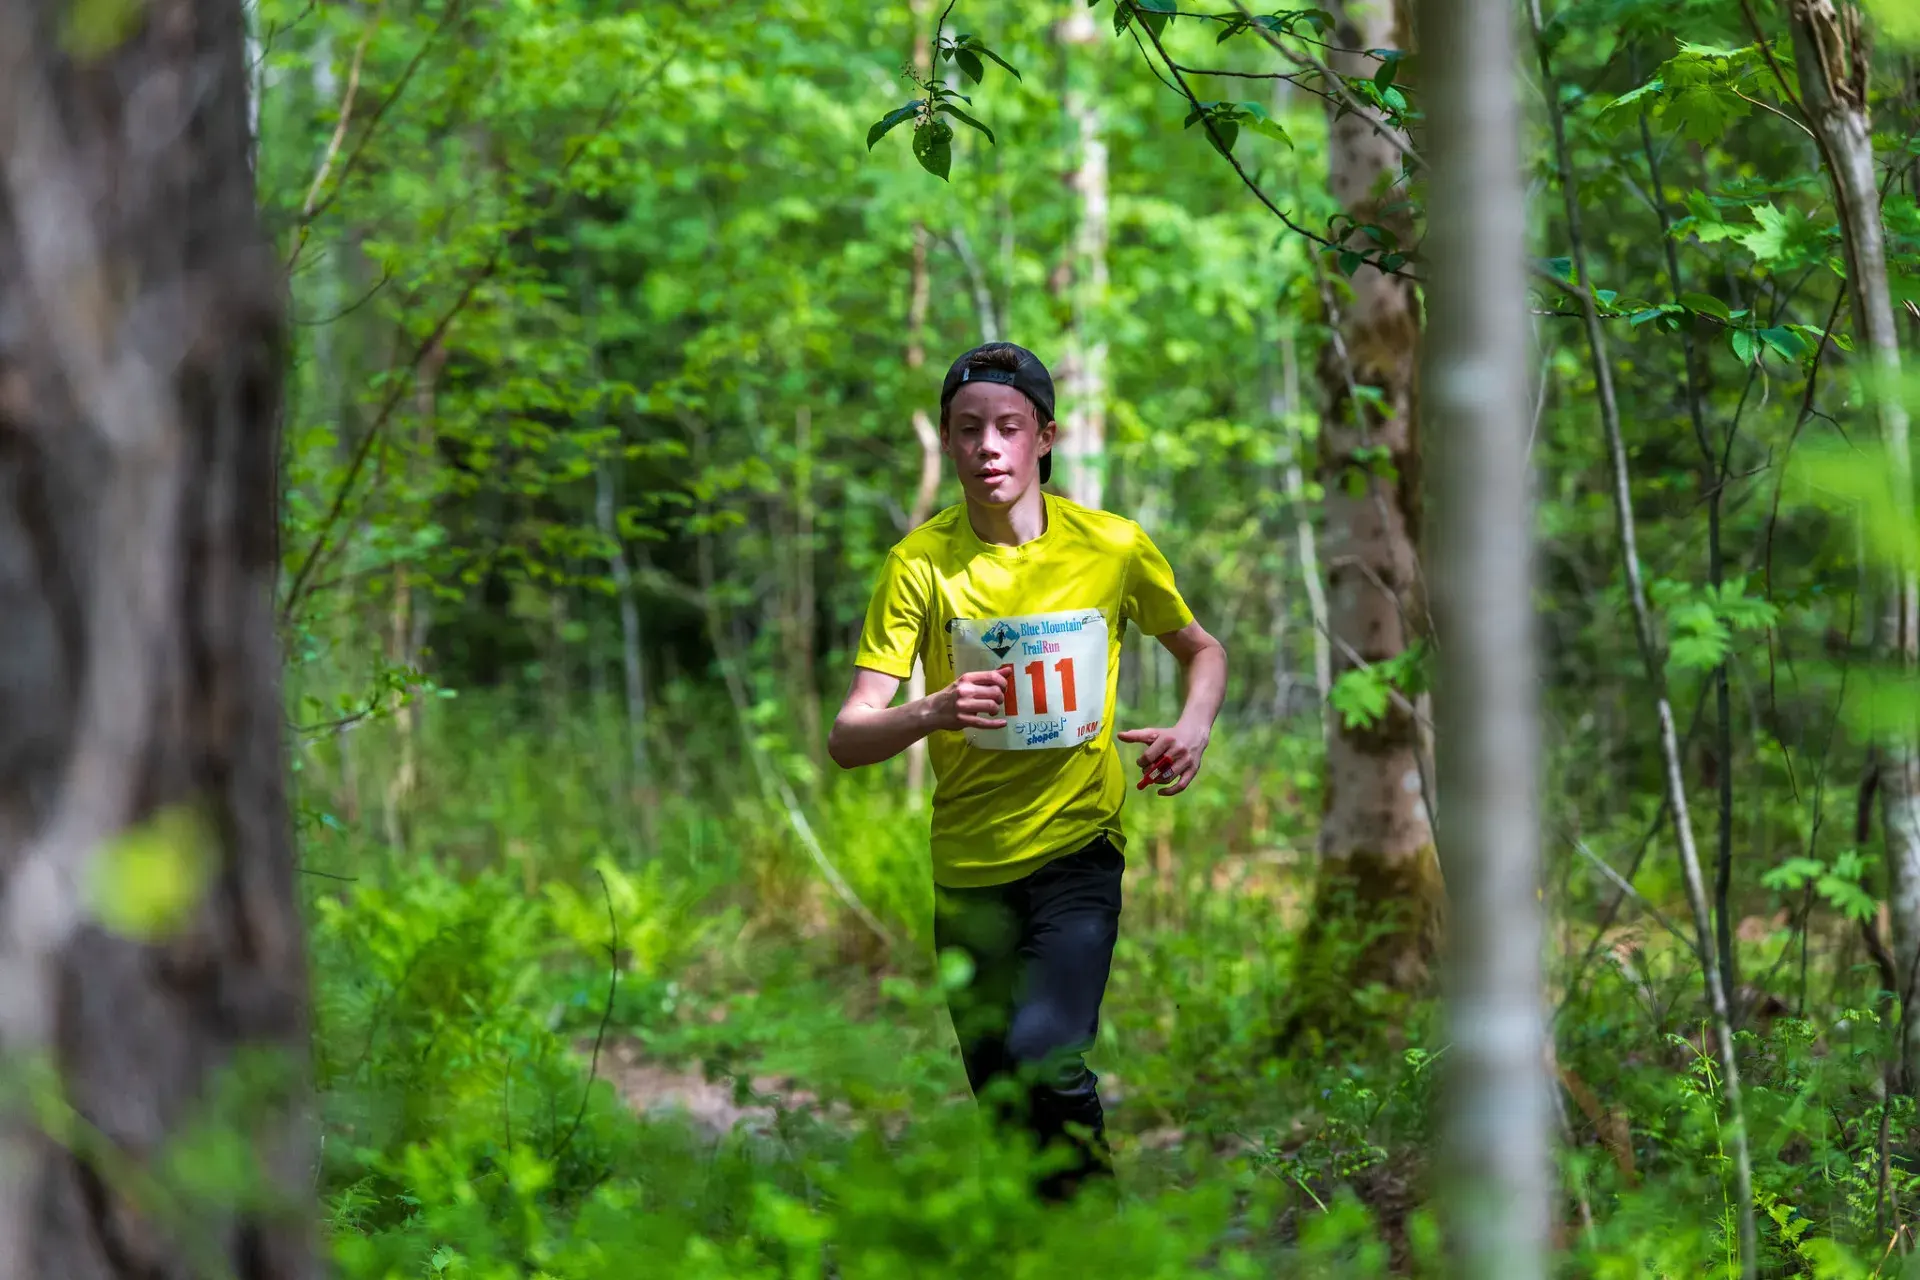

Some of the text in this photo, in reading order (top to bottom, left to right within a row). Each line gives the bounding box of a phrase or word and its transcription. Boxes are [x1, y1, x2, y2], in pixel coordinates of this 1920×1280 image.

[1020, 618, 1082, 637] Blue Mountain
[1022, 640, 1060, 656] TrailRun
[998, 657, 1077, 716] 111
[1077, 725, 1085, 737] 10
[1085, 721, 1099, 733] KM
[1027, 731, 1060, 746] shopen
